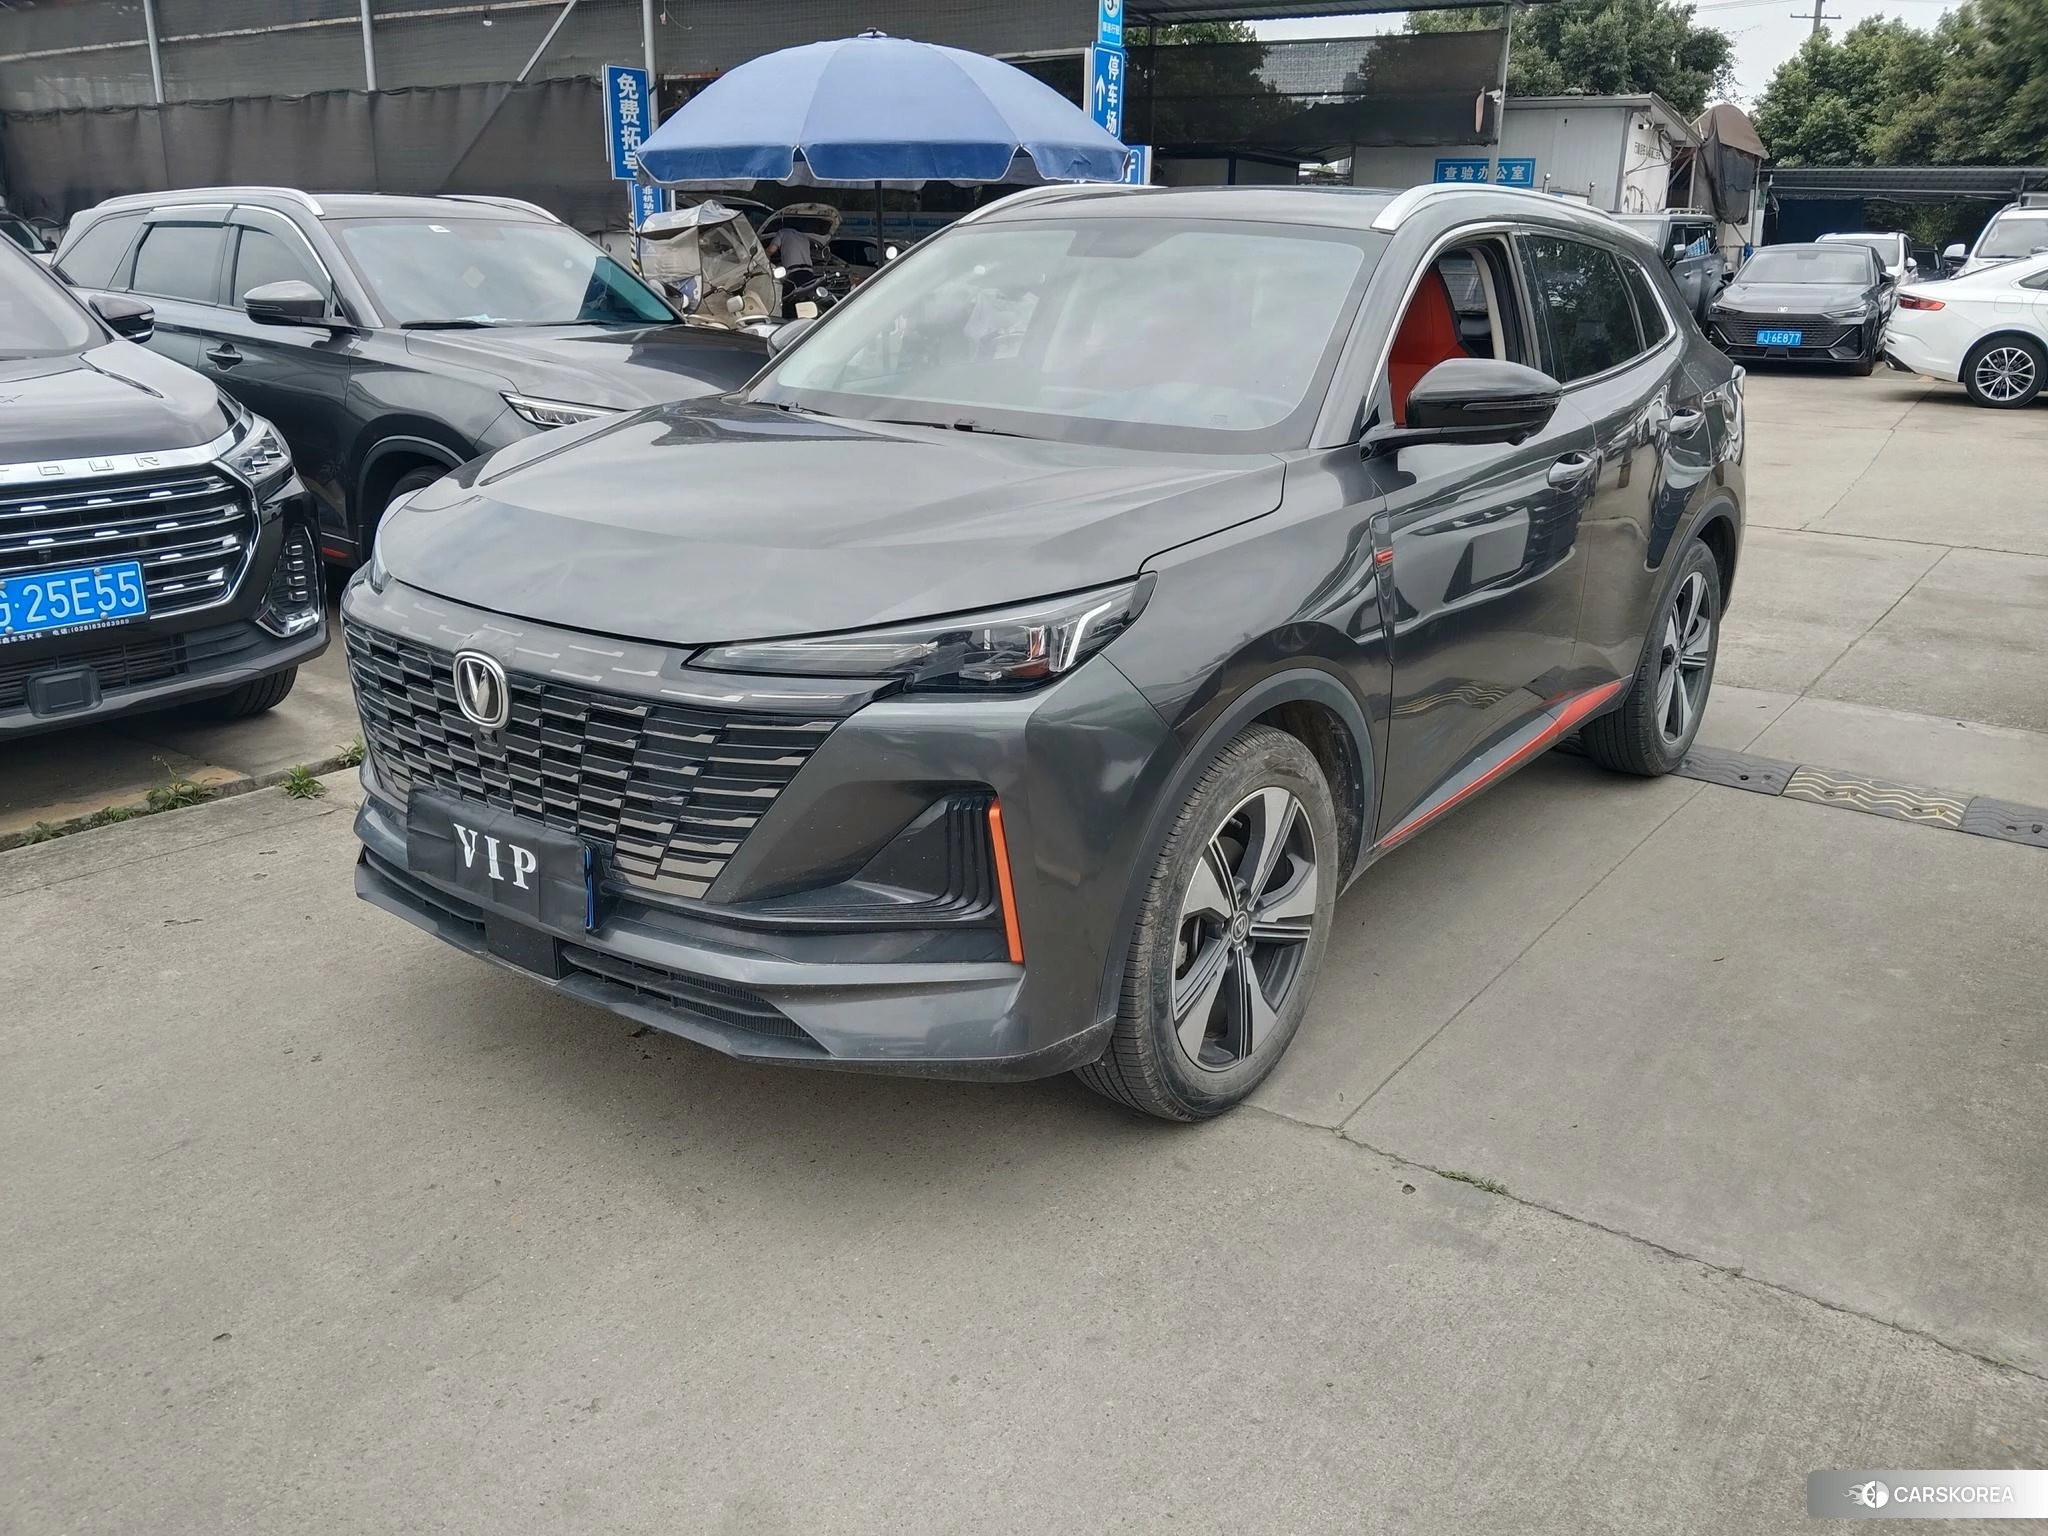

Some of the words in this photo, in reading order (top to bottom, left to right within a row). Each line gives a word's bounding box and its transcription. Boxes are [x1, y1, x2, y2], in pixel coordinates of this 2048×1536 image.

[1106, 55, 1120, 135] 停车场
[1444, 165, 1525, 180] 查验办公室
[453, 823, 537, 890] VIP
